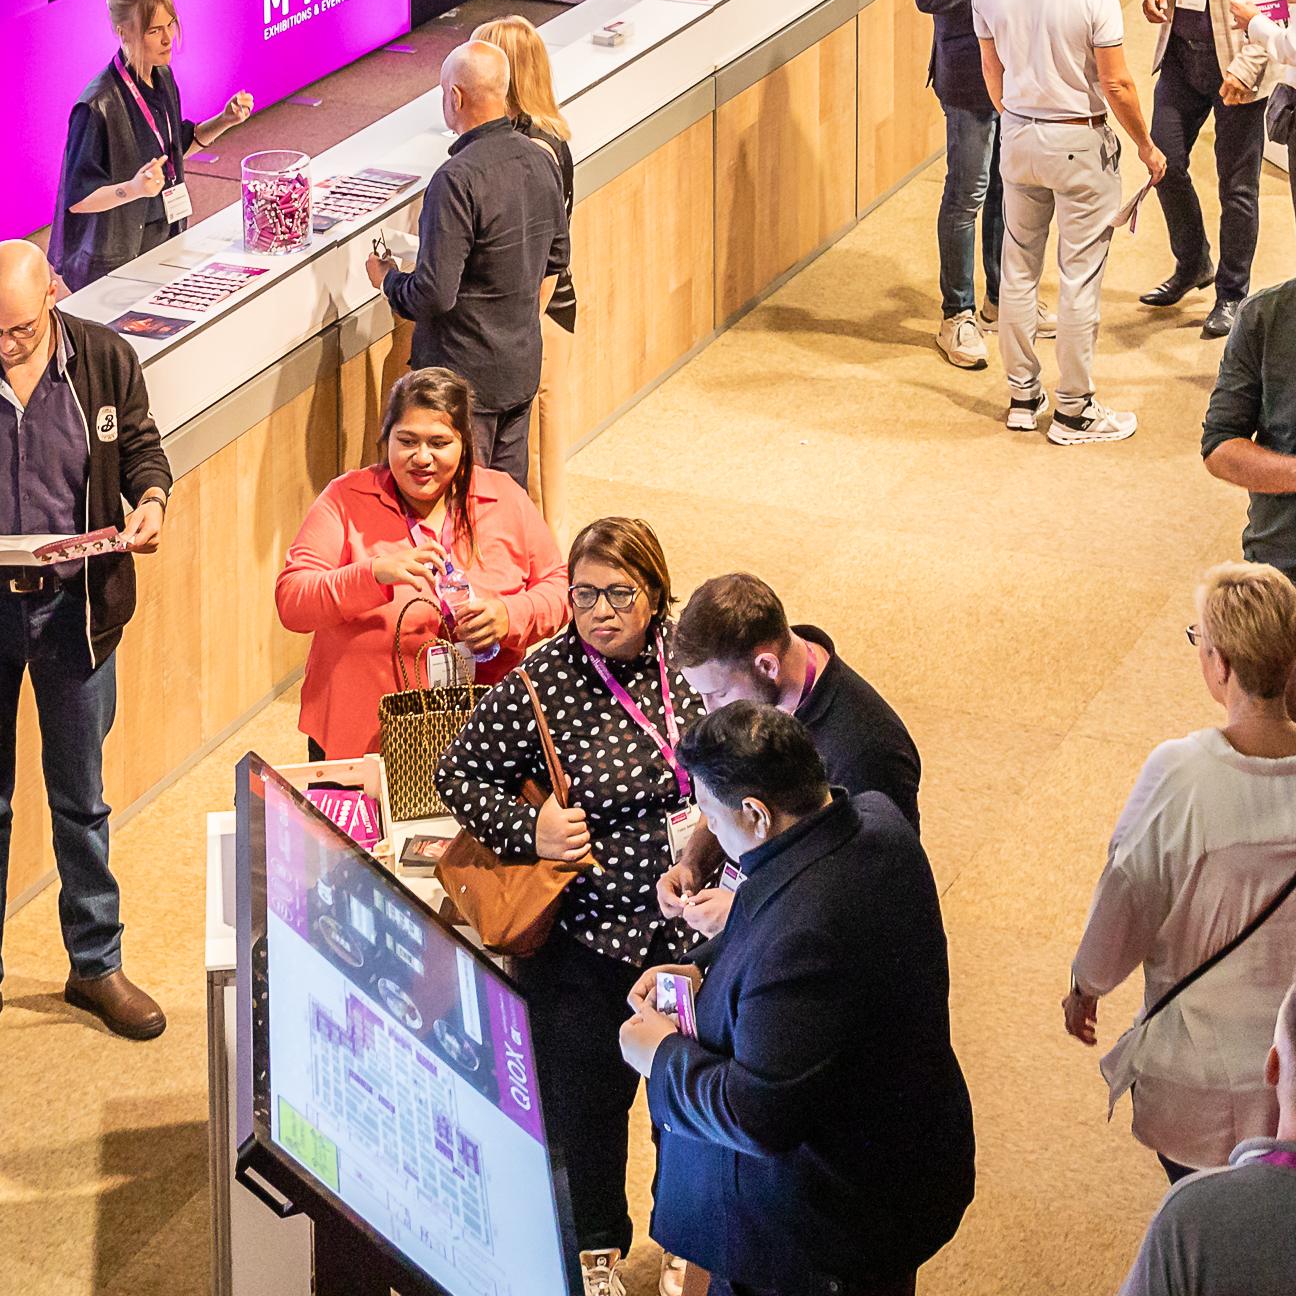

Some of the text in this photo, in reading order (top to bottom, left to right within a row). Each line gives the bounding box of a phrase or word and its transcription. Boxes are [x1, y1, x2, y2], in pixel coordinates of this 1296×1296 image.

[264, 7, 312, 41] EXHIBITIONS
[313, 3, 320, 16] &
[504, 1040, 532, 1112] QIOX
